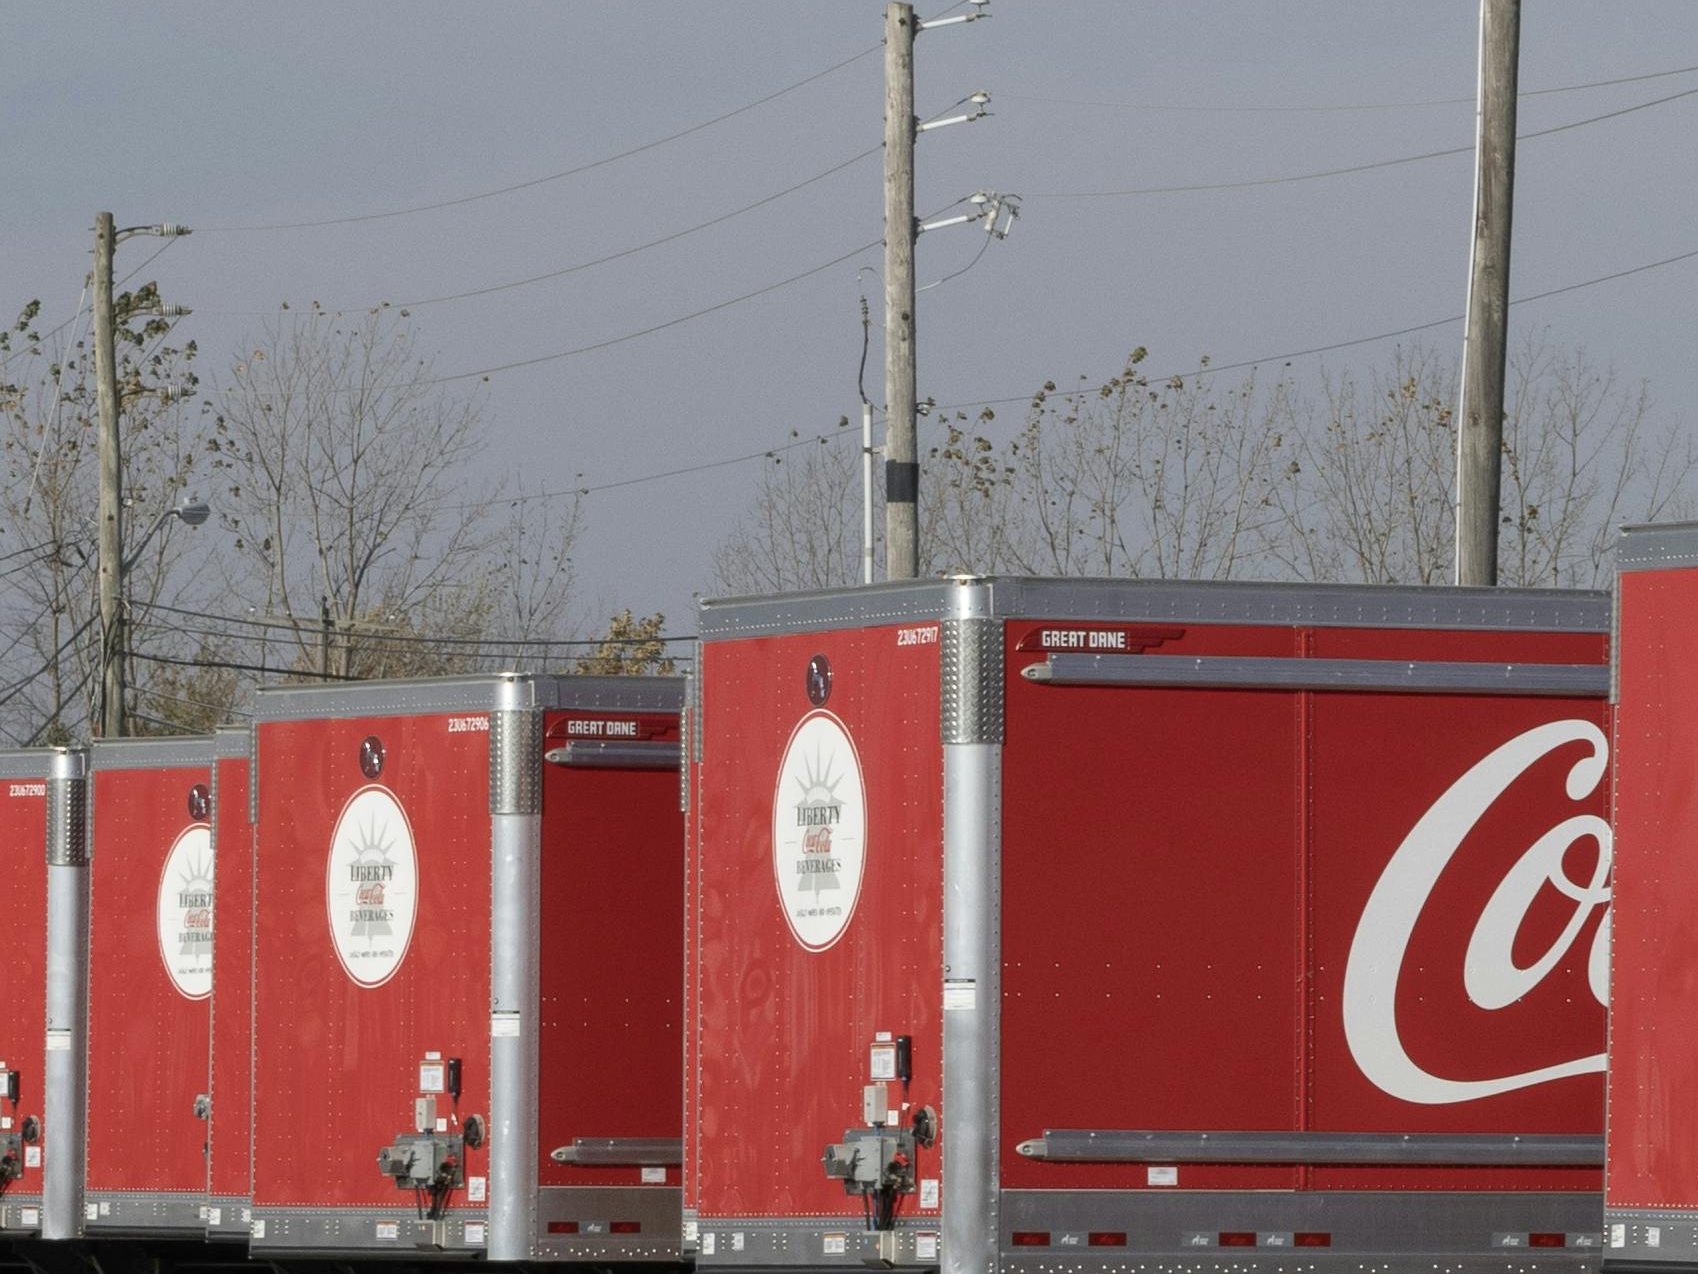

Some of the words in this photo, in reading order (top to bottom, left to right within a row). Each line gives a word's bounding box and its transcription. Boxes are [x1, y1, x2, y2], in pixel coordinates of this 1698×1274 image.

[1042, 630, 1086, 648] GREAT
[1089, 631, 1125, 649] DANE
[567, 719, 603, 736] GREAT
[606, 721, 637, 736] DANE
[796, 806, 841, 827] LIBERTY
[350, 865, 394, 882] LIBERTY
[796, 859, 842, 875] BEVERAGES
[179, 893, 214, 908] LIBERT
[350, 909, 394, 922] BEVERAGES
